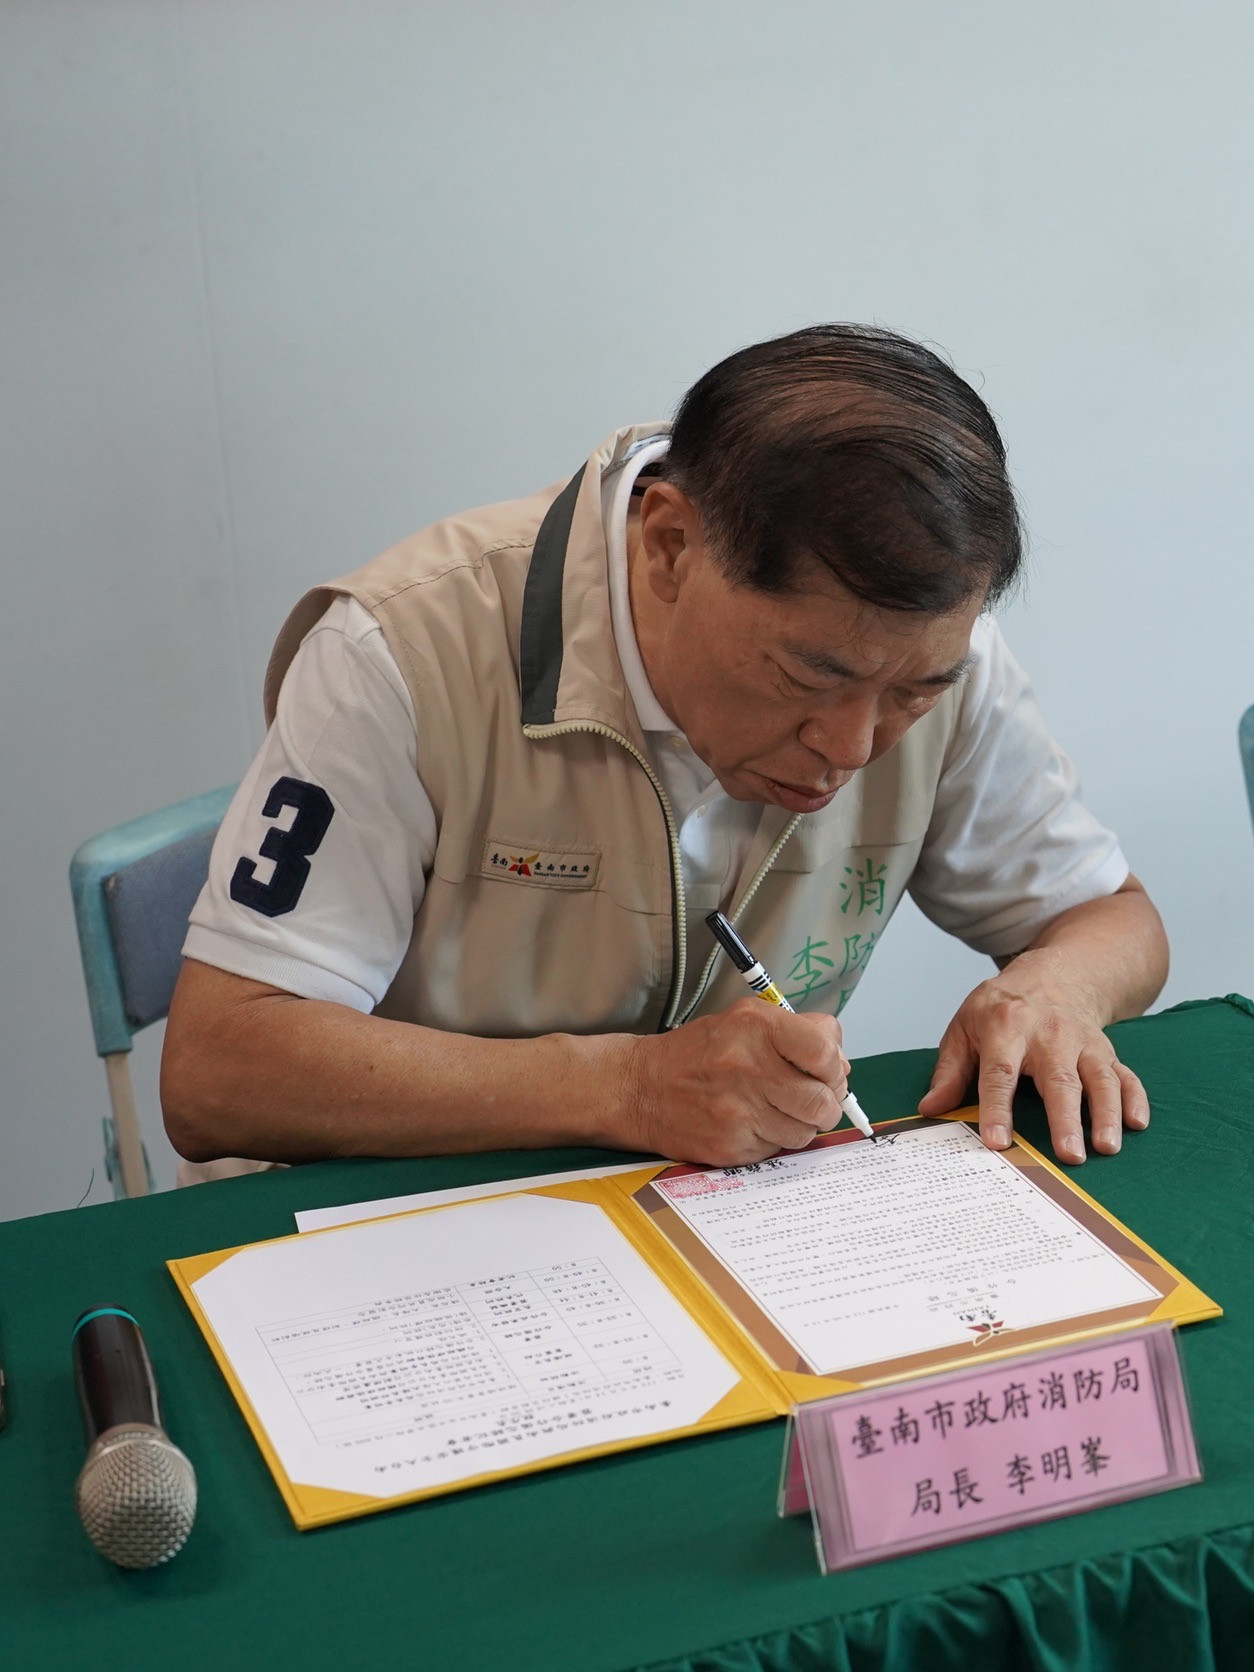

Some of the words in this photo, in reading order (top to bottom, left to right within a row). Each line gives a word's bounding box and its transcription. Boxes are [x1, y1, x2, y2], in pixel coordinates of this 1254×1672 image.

[230, 776, 335, 918] 3
[534, 862, 590, 874] 臺南市政府
[785, 936, 835, 1006] 李
[850, 1356, 1141, 1460] 臺南市政府消防局
[910, 1467, 984, 1518] 局長
[1005, 1436, 1113, 1497] 李明峯
